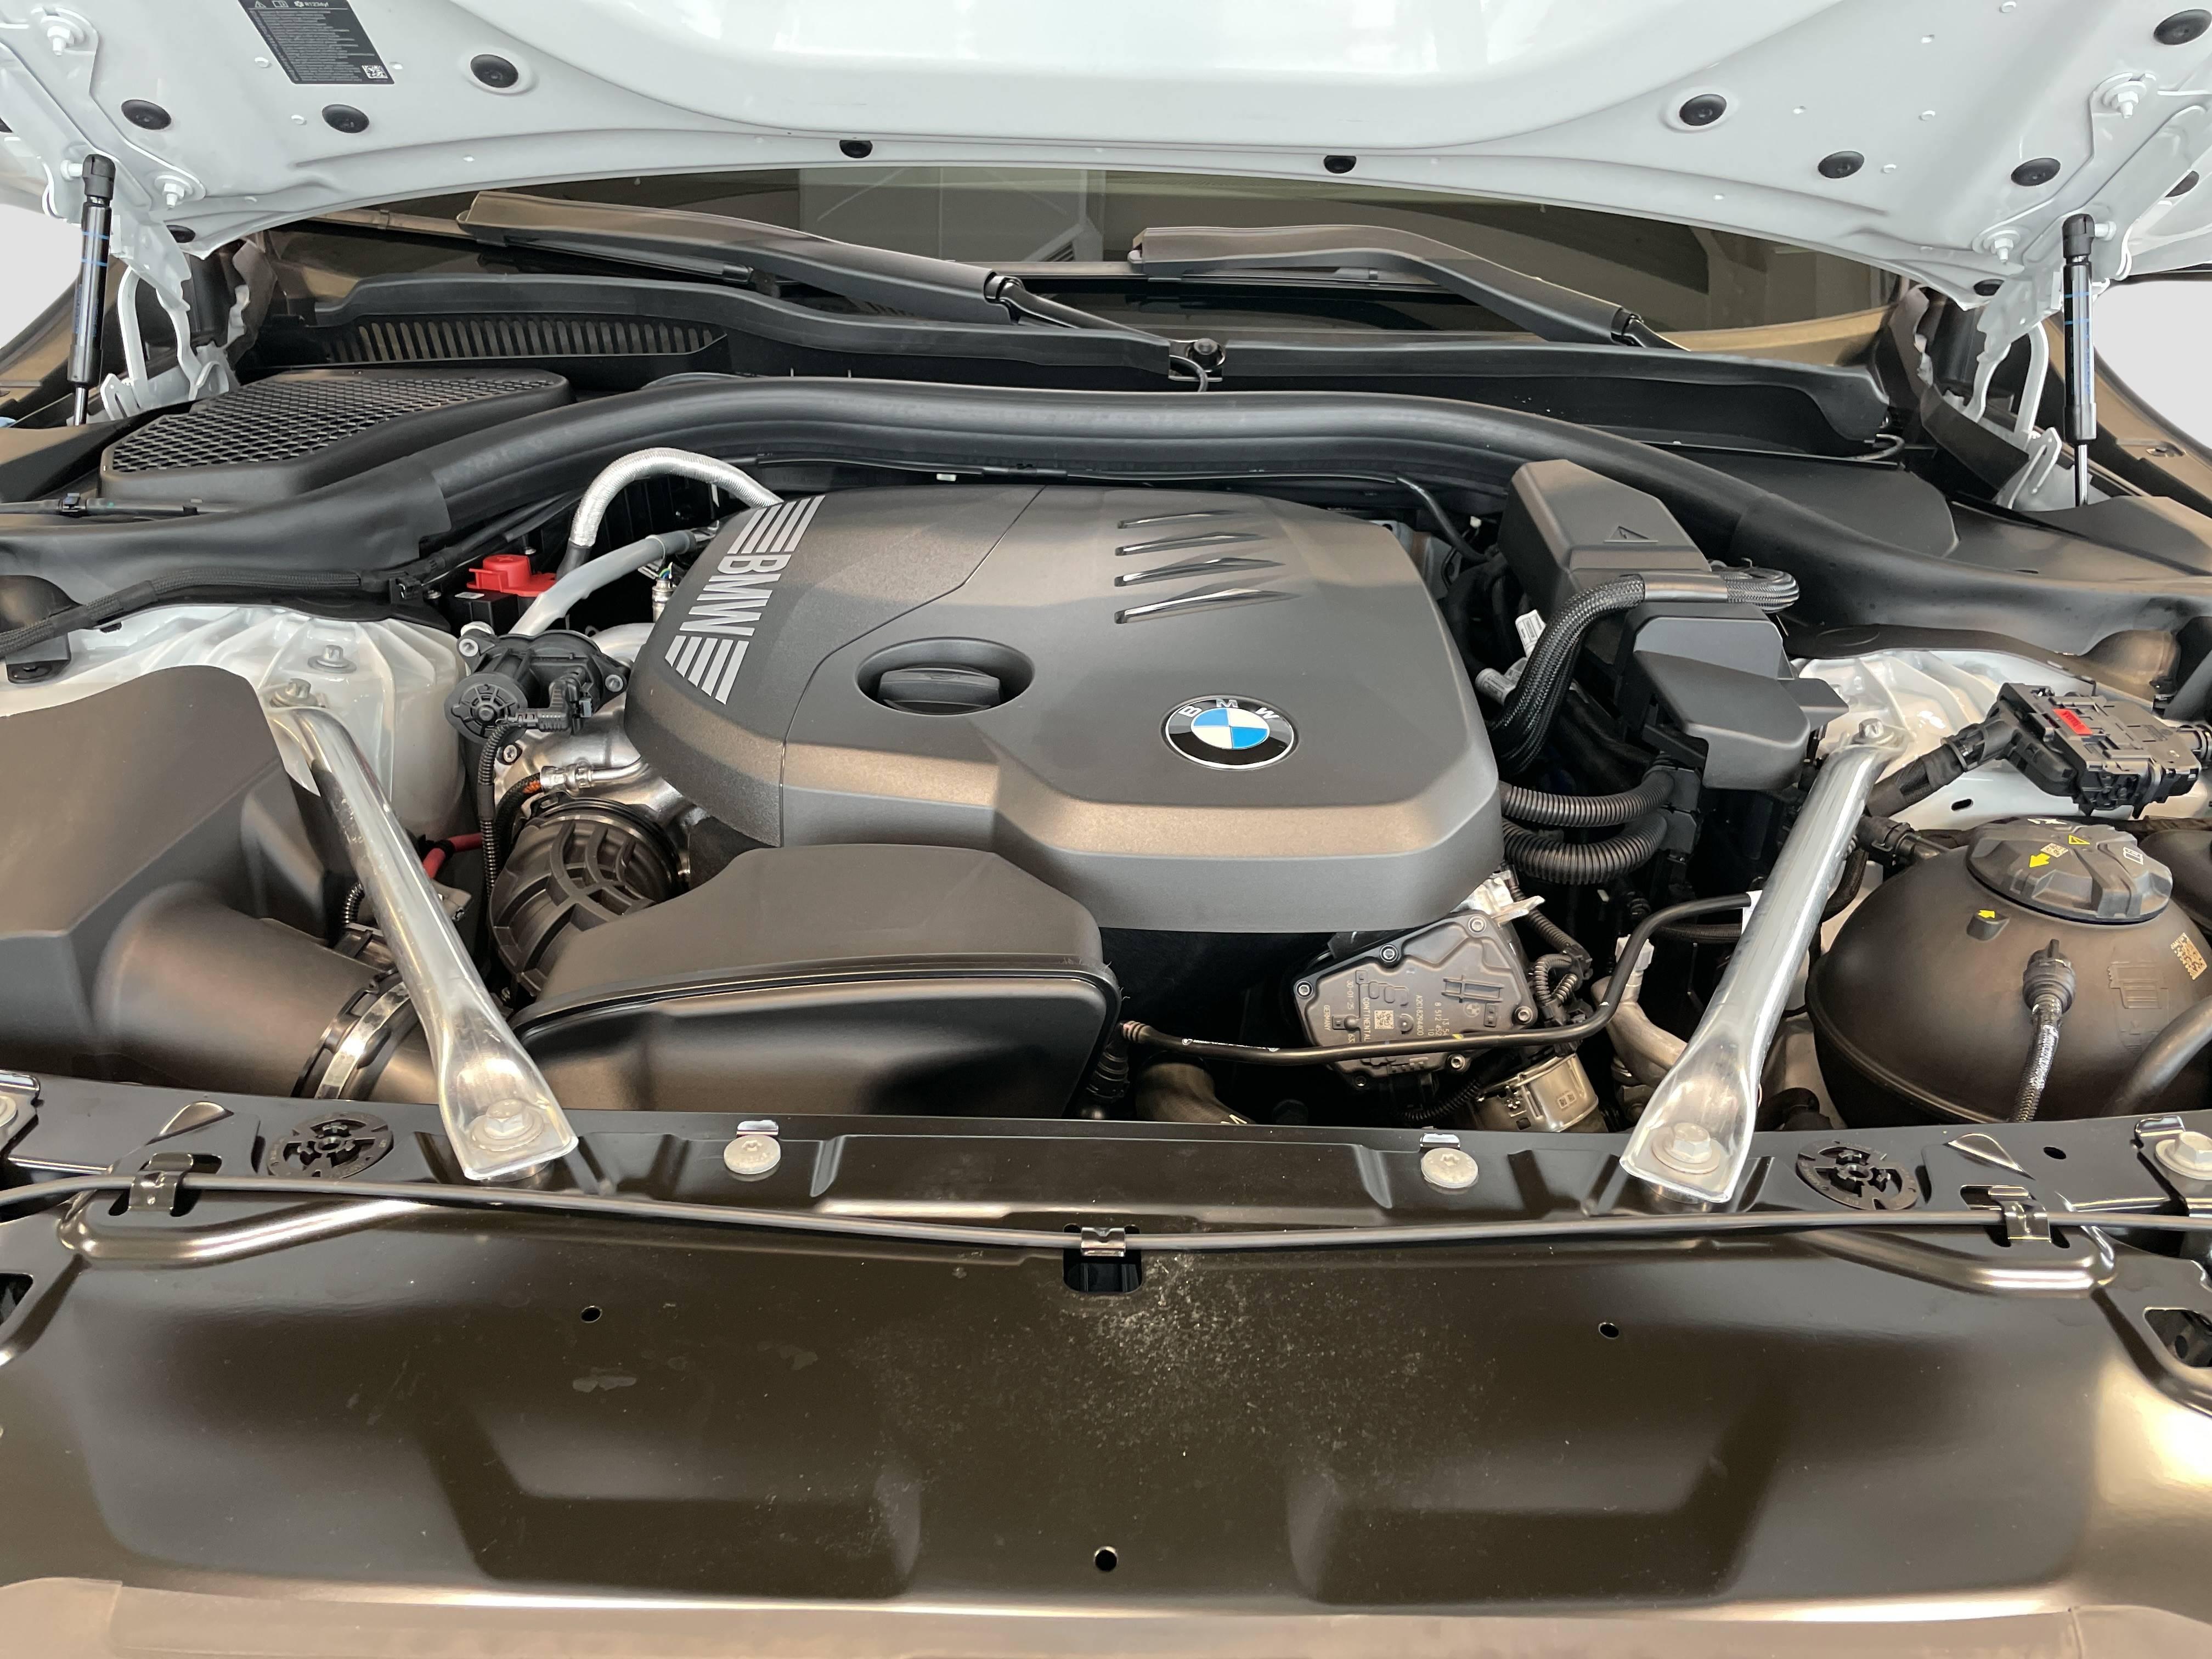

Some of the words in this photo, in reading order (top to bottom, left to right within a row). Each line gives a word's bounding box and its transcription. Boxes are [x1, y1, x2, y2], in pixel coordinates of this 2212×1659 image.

[679, 554, 792, 636] BMW
[1178, 698, 1279, 720] BMW
[1363, 997, 1371, 1041] CONTINENTAL
